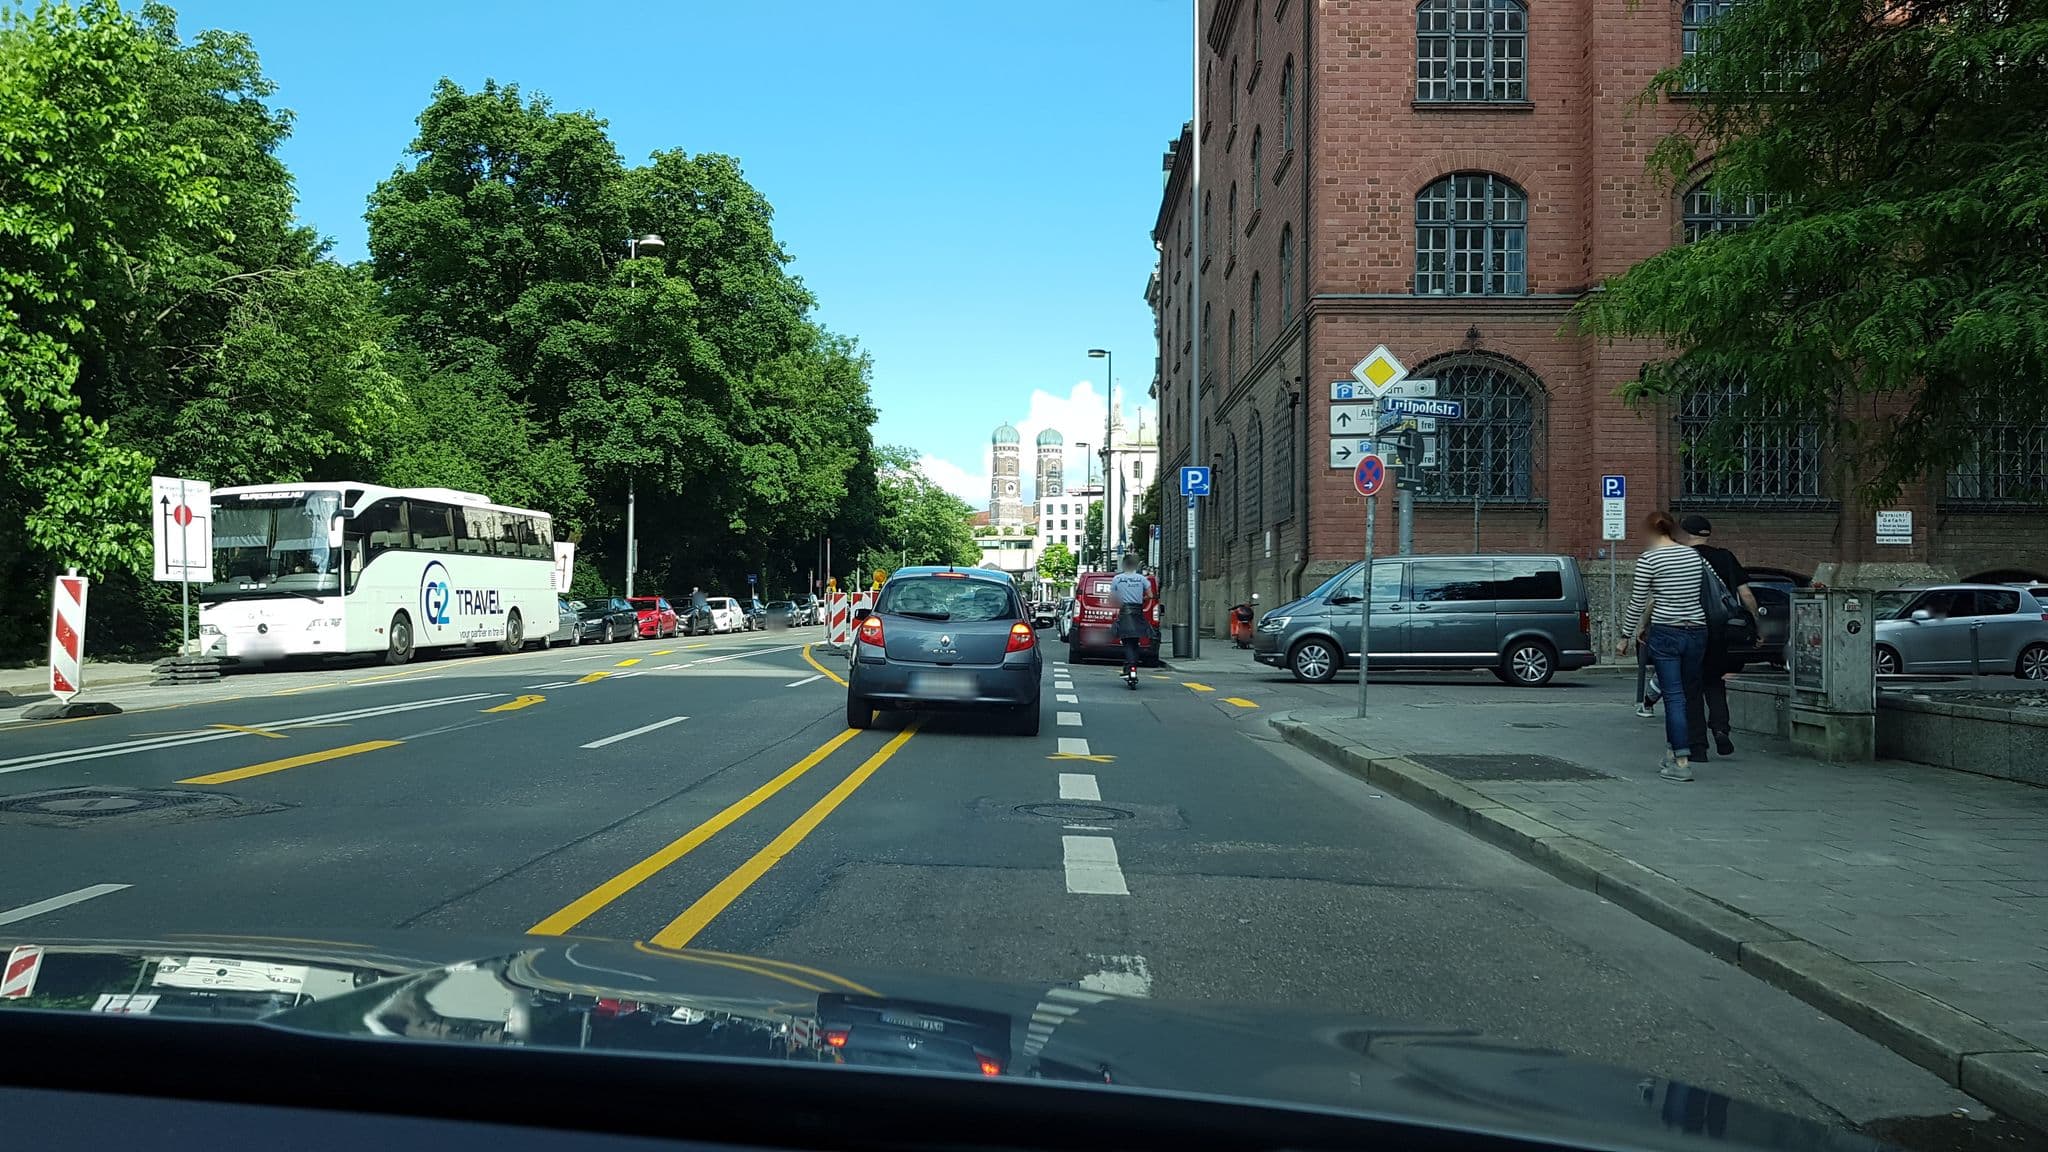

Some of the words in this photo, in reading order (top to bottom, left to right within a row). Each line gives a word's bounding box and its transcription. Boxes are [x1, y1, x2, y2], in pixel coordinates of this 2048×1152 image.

[1388, 398, 1456, 416] Luitpoldstr.
[1421, 420, 1434, 429] frei
[1424, 456, 1434, 464] rei
[425, 581, 450, 625] G2
[455, 589, 504, 615] TRAVEL
